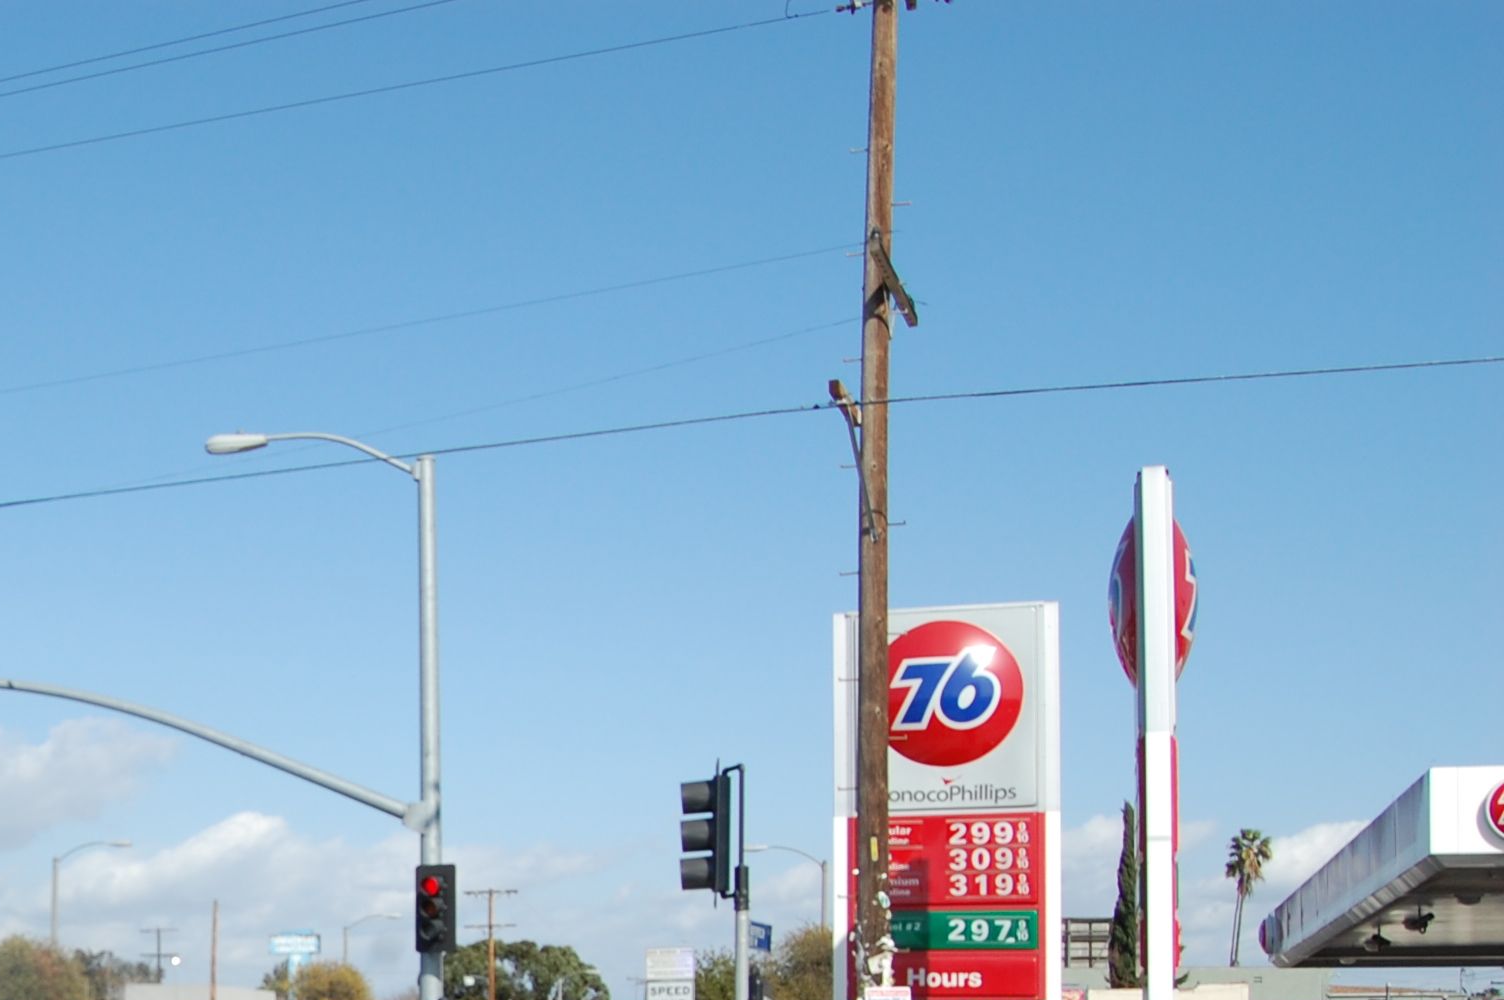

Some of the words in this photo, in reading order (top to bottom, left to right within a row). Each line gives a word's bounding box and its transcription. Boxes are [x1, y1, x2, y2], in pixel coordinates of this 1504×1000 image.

[889, 645, 1002, 731] 76
[889, 783, 1017, 804] onocoPhillips
[948, 821, 1014, 846] 299
[948, 847, 1014, 871] 309
[949, 873, 1014, 897] 319
[947, 918, 1013, 942] 297
[906, 967, 982, 988] Hours
[650, 986, 691, 996] SPEED
